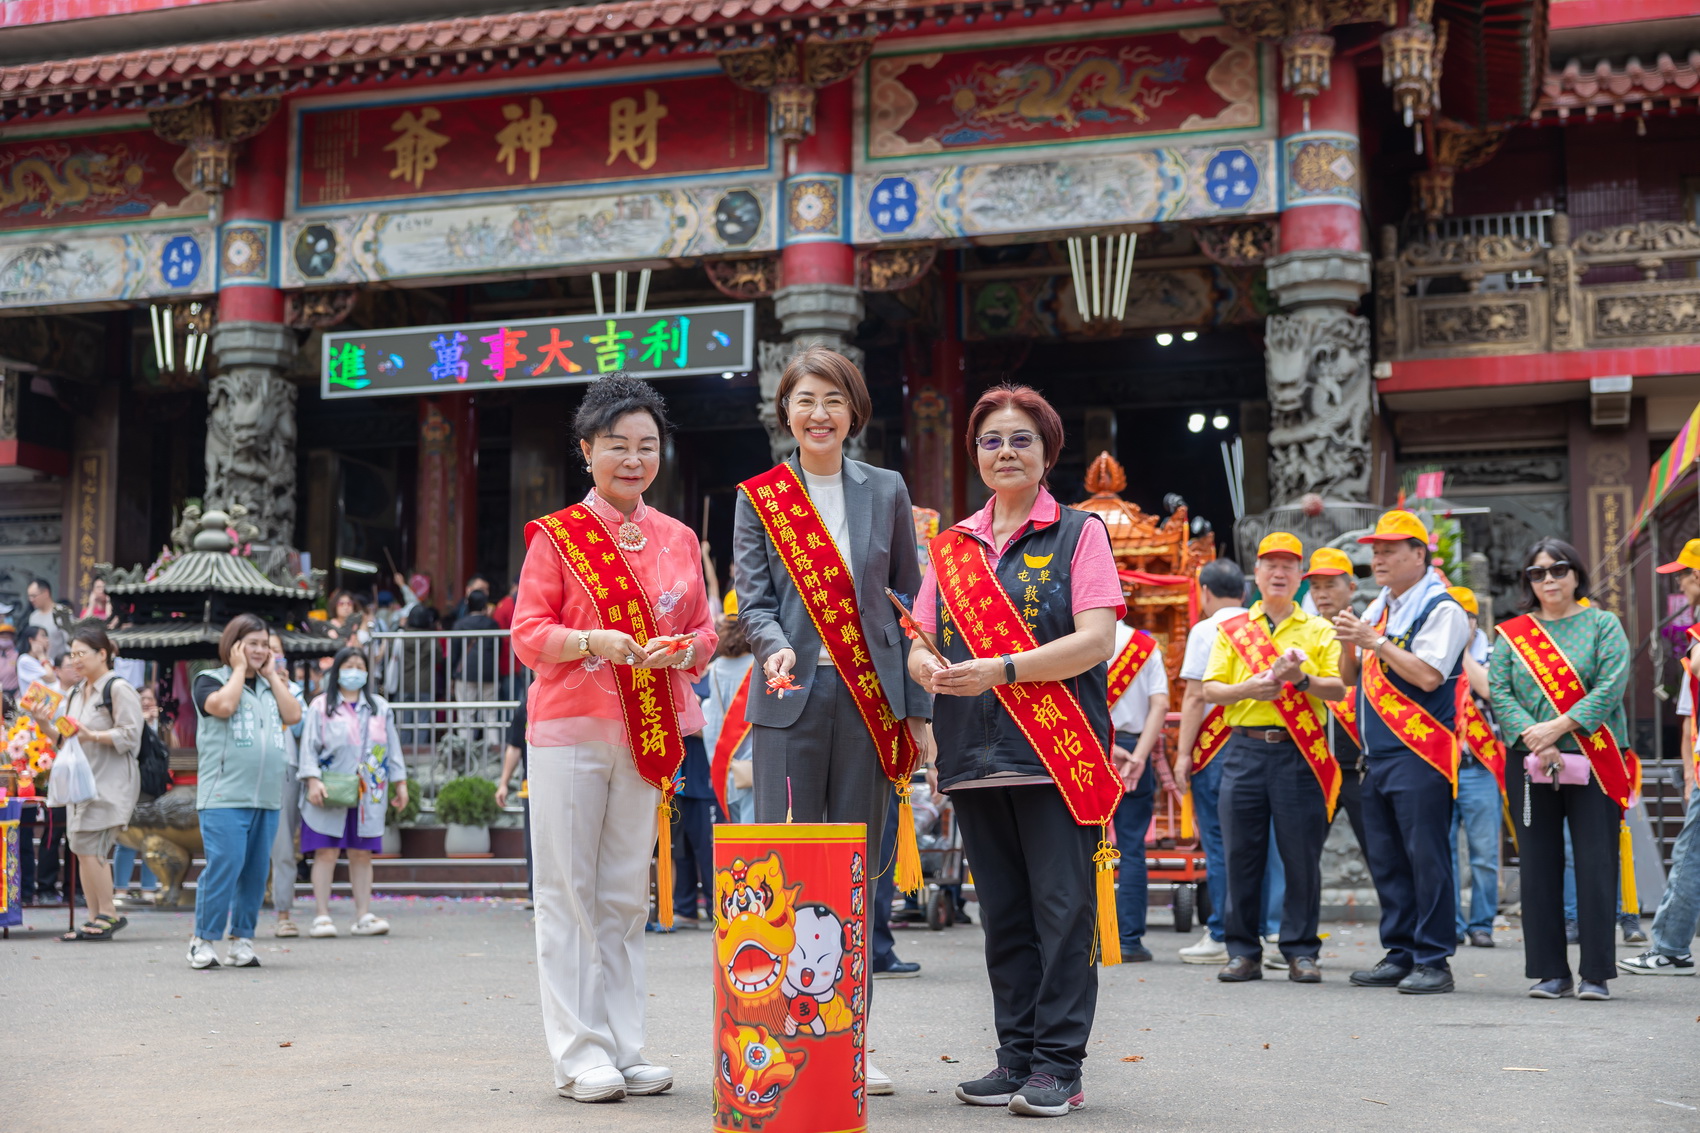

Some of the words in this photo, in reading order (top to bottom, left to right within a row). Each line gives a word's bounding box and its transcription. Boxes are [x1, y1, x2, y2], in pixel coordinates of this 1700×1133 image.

[383, 89, 667, 189] 財神爺
[329, 342, 371, 390] 進
[428, 315, 691, 383] 萬事大吉利
[541, 514, 609, 600] 祖廟五路財神爺
[1032, 694, 1096, 792] 賴怡伶
